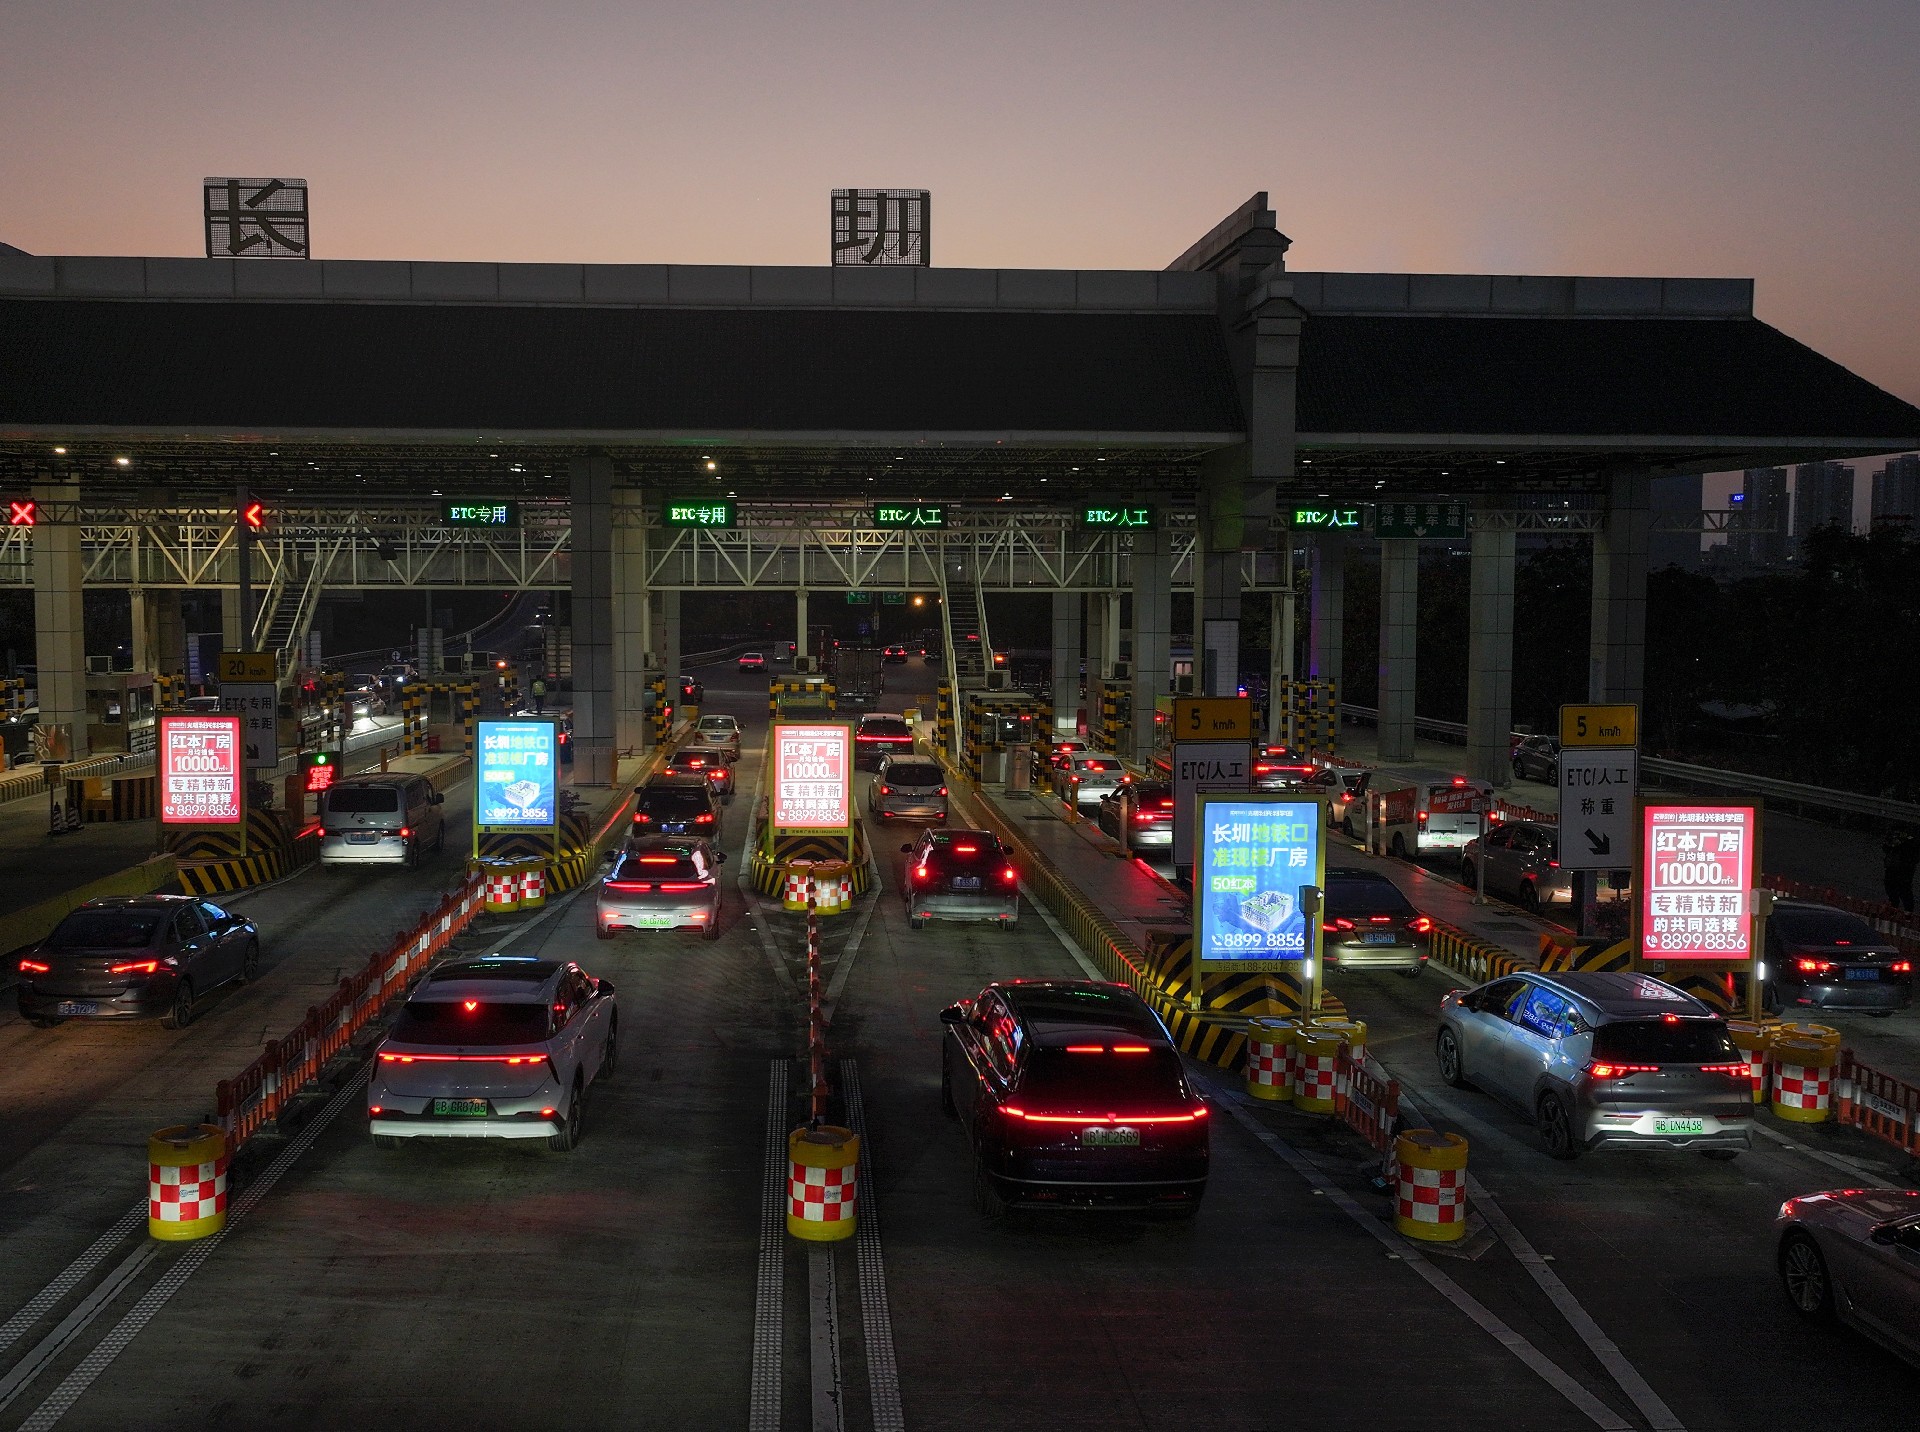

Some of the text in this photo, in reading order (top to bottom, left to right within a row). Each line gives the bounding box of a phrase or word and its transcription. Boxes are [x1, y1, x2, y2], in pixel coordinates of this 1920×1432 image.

[205, 178, 308, 256] 长
[832, 188, 930, 264] 圳
[450, 505, 506, 523] ETC专用
[671, 505, 726, 524] ETC专用
[879, 508, 942, 526] ETC/人工
[1086, 508, 1148, 526] ETC/人工
[1296, 509, 1359, 527] ETC/人工
[228, 660, 266, 676] 20 km/h
[1190, 708, 1236, 730] 5 km/h
[1577, 715, 1621, 737] 5 km/h
[172, 734, 231, 749] 红本厂房
[784, 742, 840, 757] 红本厂房
[1181, 760, 1243, 780] ETC/人工
[1567, 767, 1629, 786] ETC/人工
[171, 778, 231, 791] 专精特新
[171, 793, 232, 805] 的共同选择
[1581, 797, 1615, 816] 称重
[177, 805, 238, 817] 8899 8856
[788, 809, 846, 821] 8899 8856
[1212, 822, 1309, 844] 长圳地铁口
[1656, 831, 1739, 852] 红本厂房
[1212, 846, 1309, 868] 准现楼厂房
[1677, 852, 1715, 862] 月均销售
[1213, 877, 1255, 891] 50红本
[1654, 894, 1738, 914] 专精特新
[1653, 917, 1739, 933] 的共同选择
[1224, 932, 1305, 947] 8899 8856
[1661, 933, 1747, 950] 8899 8856
